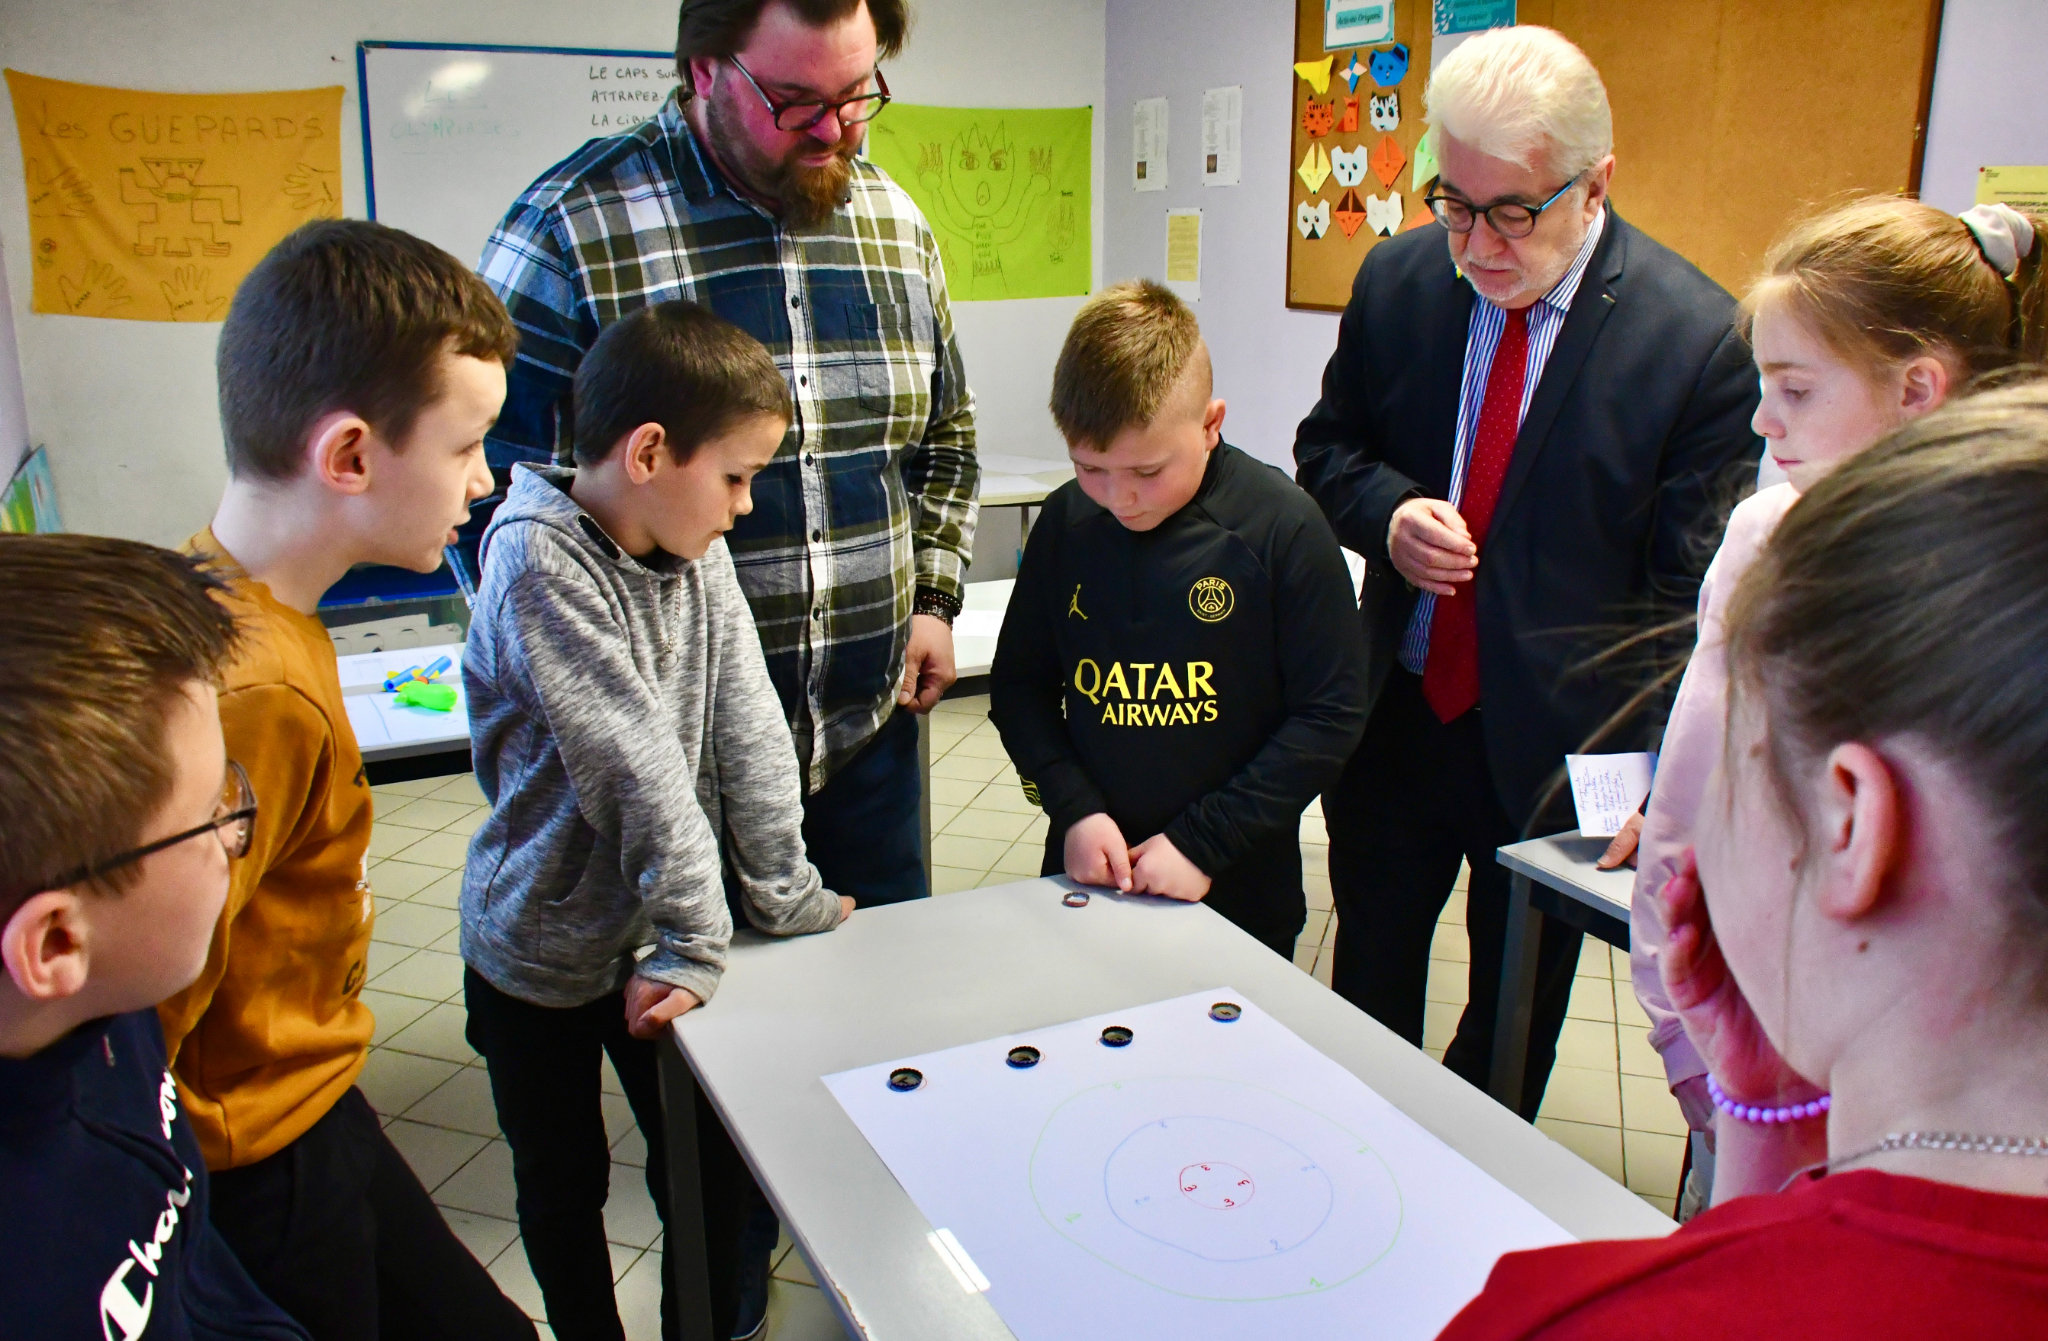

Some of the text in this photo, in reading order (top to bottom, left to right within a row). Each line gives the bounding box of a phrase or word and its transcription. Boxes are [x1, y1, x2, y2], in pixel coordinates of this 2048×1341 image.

[589, 65, 608, 80] LE
[616, 67, 649, 79] CAPS
[41, 101, 325, 145] Les GUEPARDS
[591, 113, 609, 127] LA
[1196, 579, 1226, 591] PARIS
[1074, 658, 1217, 705] QATAR
[1101, 699, 1219, 727] AIRWAYS
[1223, 1198, 1235, 1208] 3
